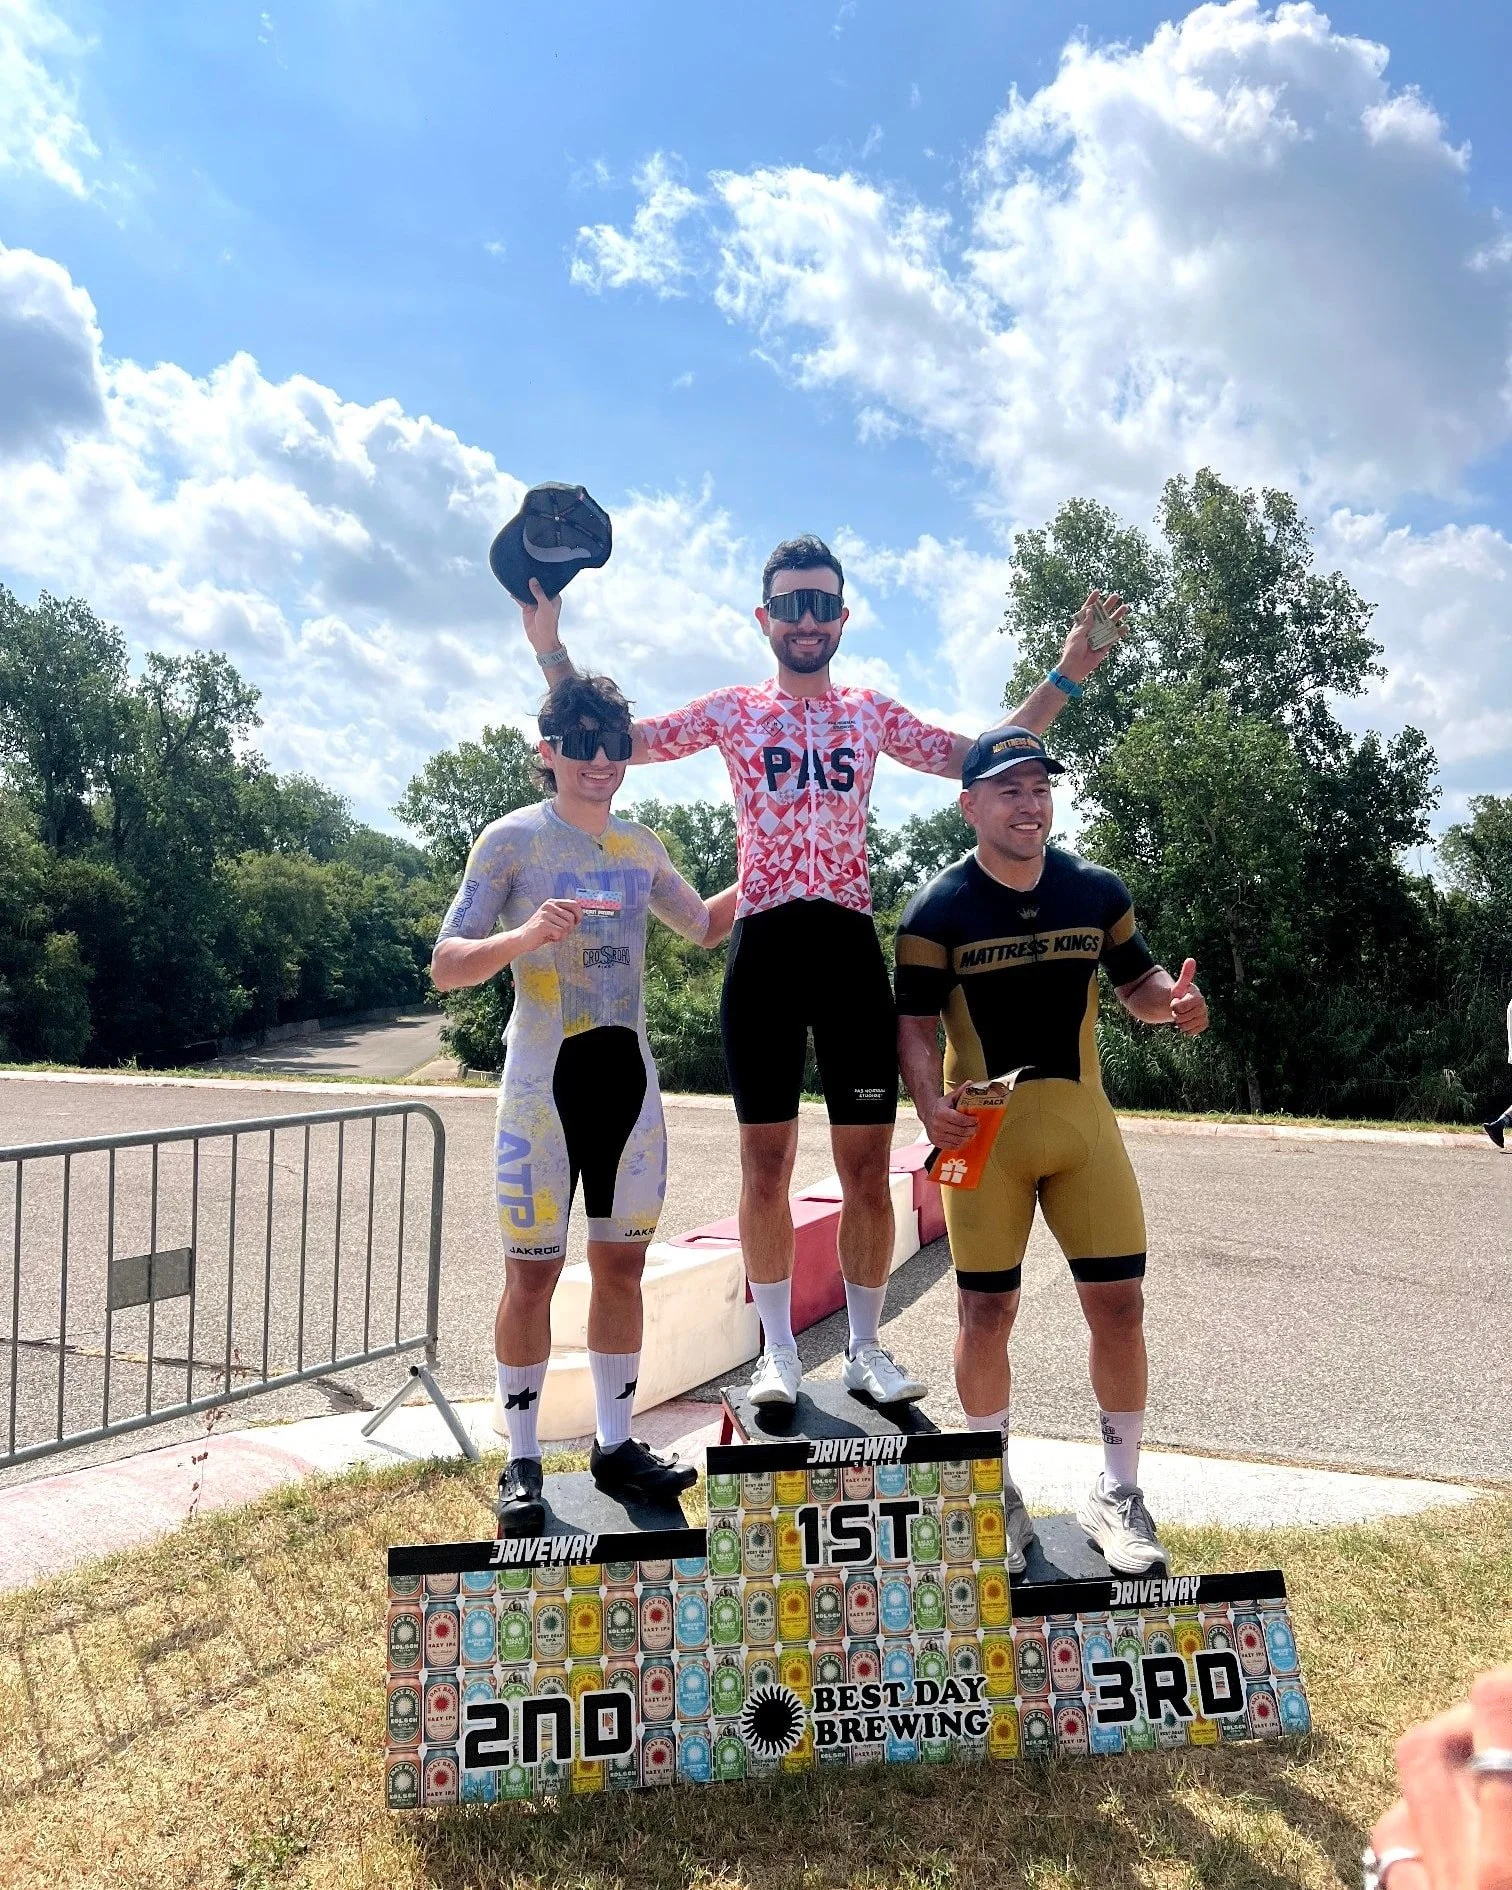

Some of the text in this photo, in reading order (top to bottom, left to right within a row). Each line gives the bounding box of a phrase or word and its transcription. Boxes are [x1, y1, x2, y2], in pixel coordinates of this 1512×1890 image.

[762, 746, 856, 793] PAS
[959, 934, 1100, 969] MATTRESS KINGS
[498, 1130, 536, 1229] ATP
[624, 1226, 656, 1236] JAKR
[510, 1246, 560, 1256] JAKROO
[807, 1434, 908, 1464] DRIVEWAY
[489, 1534, 600, 1564] DRIVEWAY
[798, 1500, 920, 1565] 1ST
[1109, 1576, 1201, 1606] DRIVEWAY
[814, 1676, 987, 1714] BEST DAY
[1091, 1651, 1245, 1722] 3RD
[464, 1691, 633, 1769] 2ND
[815, 1709, 990, 1746] BREWING
